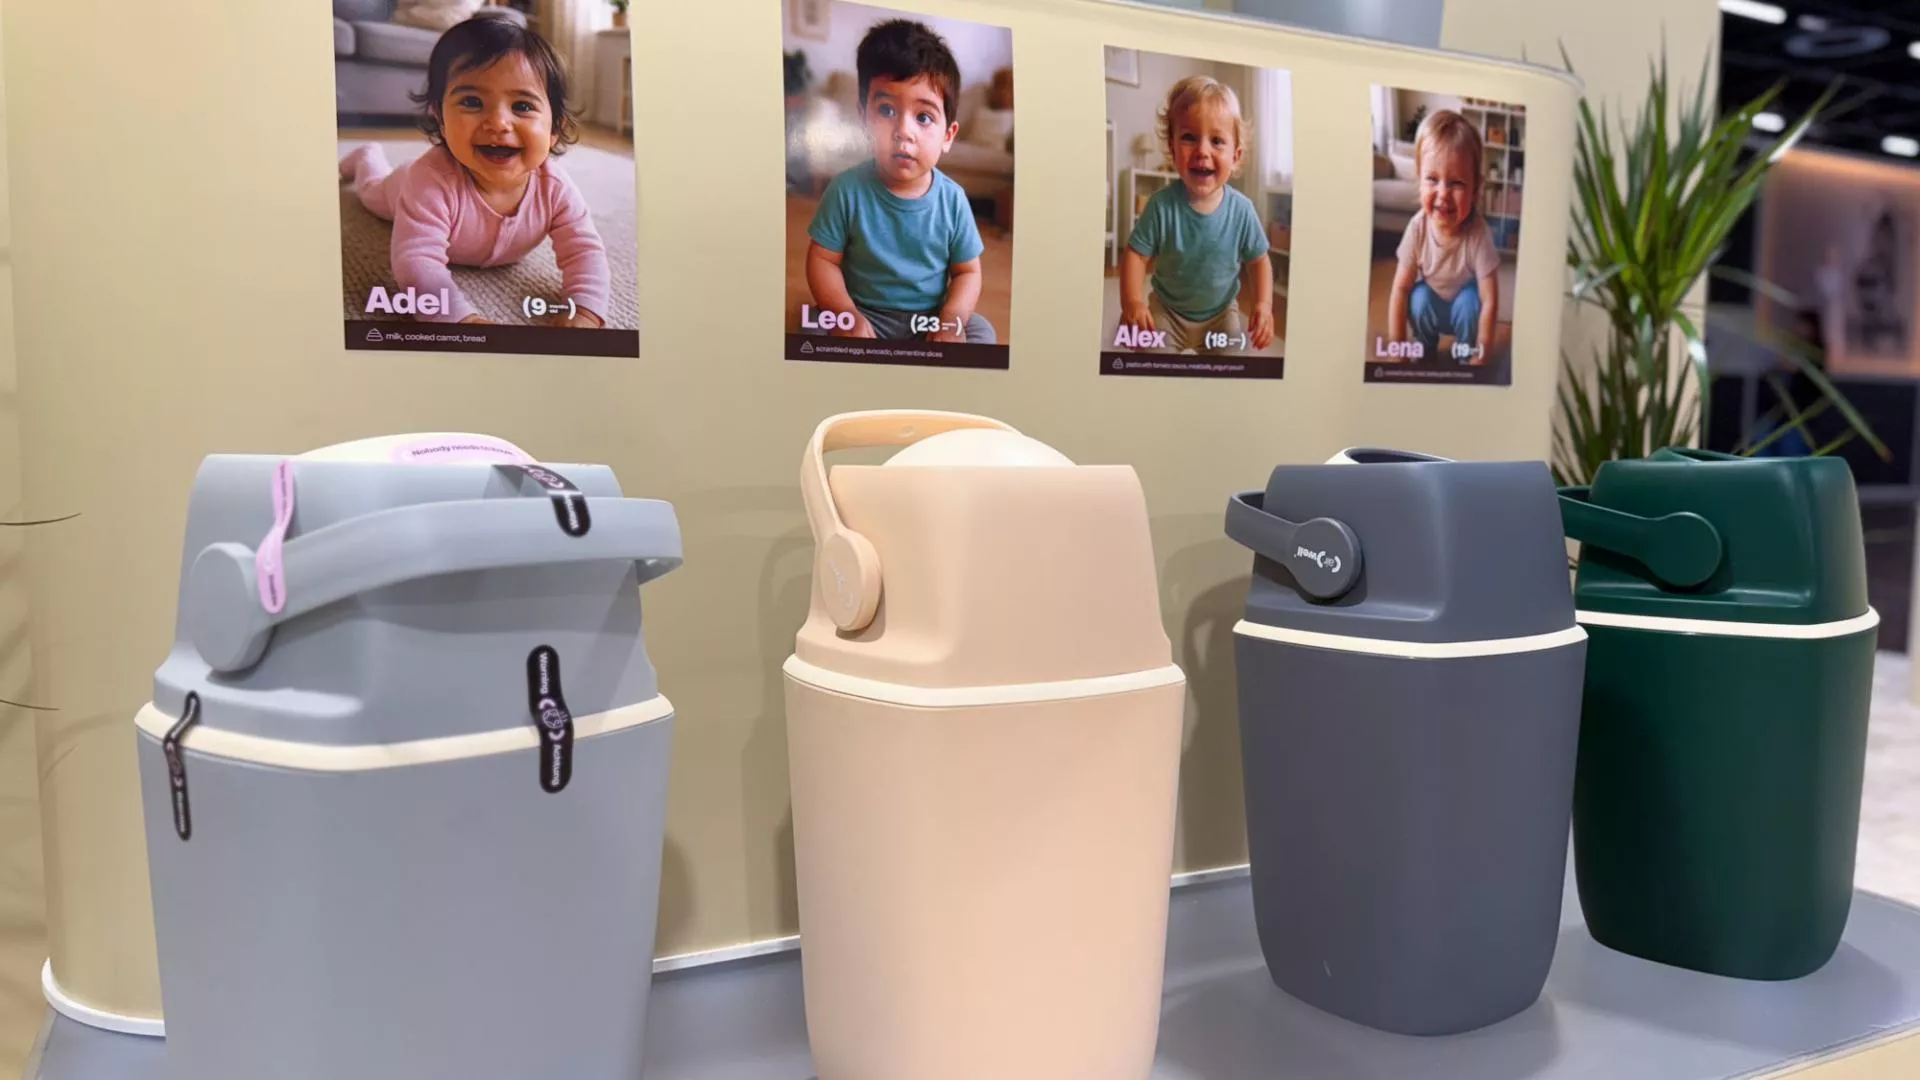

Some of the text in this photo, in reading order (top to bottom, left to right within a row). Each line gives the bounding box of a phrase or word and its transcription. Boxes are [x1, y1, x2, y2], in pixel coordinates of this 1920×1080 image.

[365, 286, 449, 315] Adel
[801, 304, 855, 331] Leo
[385, 332, 487, 343] milk, cooked carrot, bread
[1114, 325, 1166, 348] Alex
[1376, 337, 1424, 358] Lena
[816, 346, 849, 354] scrambled
[539, 651, 549, 694] Warning
[551, 743, 563, 787] Achtung
